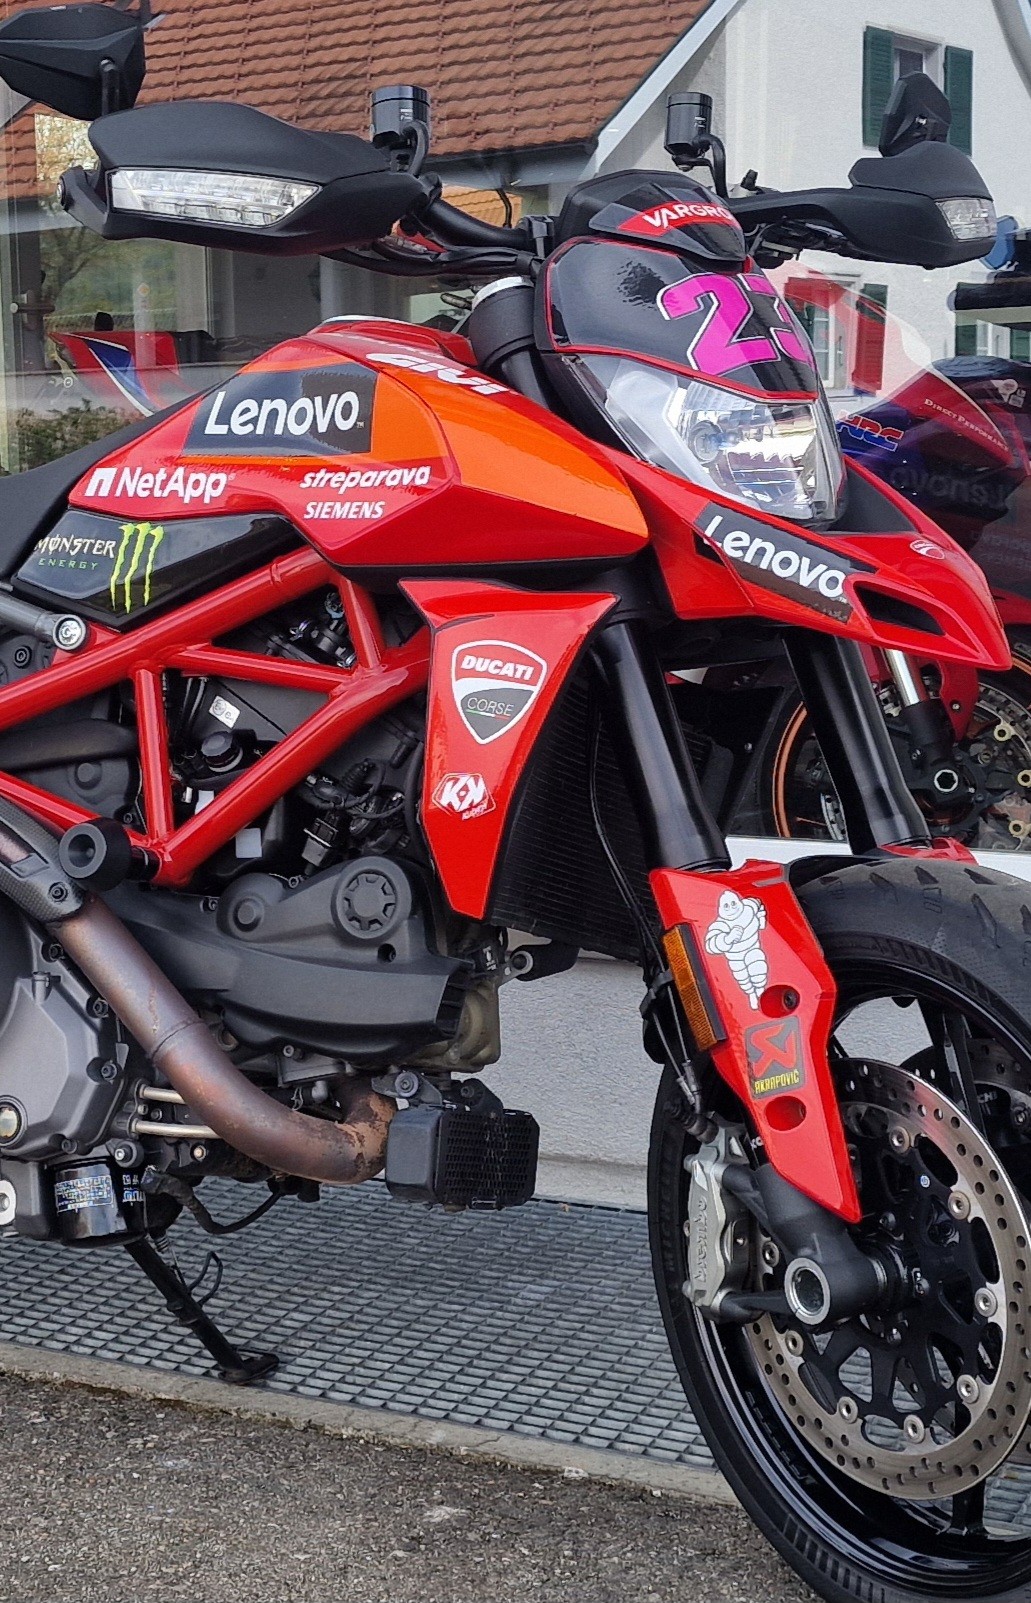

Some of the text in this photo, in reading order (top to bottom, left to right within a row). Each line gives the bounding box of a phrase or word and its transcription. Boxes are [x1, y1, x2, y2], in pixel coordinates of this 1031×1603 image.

[204, 391, 360, 435] Lenovo
[115, 466, 228, 504] NetApp
[299, 466, 431, 494] streparava
[304, 501, 386, 519] SIEMENS
[34, 534, 117, 559] MONSTER
[703, 515, 847, 597] Lenovo
[38, 558, 98, 571] ENERGY
[461, 654, 535, 680] DUCATI
[467, 697, 514, 716] CORSE
[692, 1195, 707, 1284] brembo
